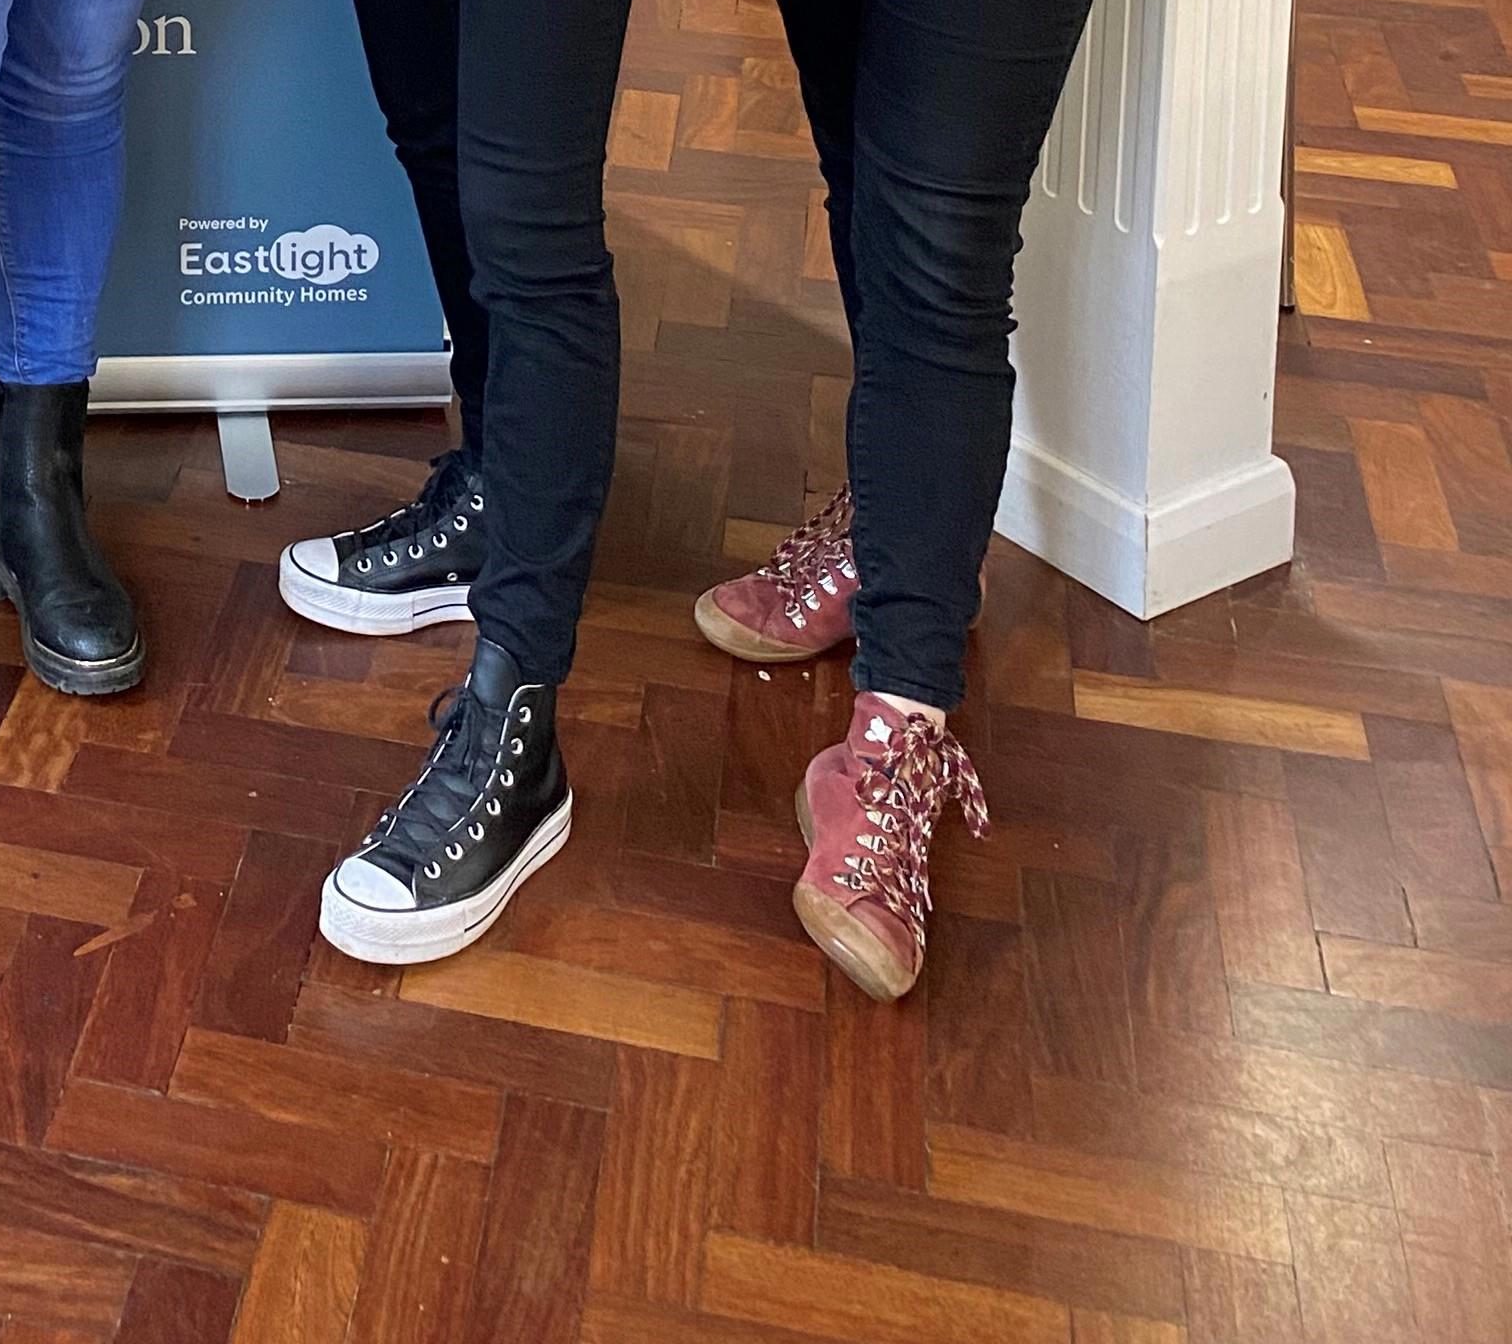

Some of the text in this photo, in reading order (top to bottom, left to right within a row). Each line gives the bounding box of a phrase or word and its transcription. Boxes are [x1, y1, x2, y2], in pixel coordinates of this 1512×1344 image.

[179, 216, 269, 232] Powered by
[179, 242, 368, 278] Eastlight
[180, 287, 368, 307] Community Homes
